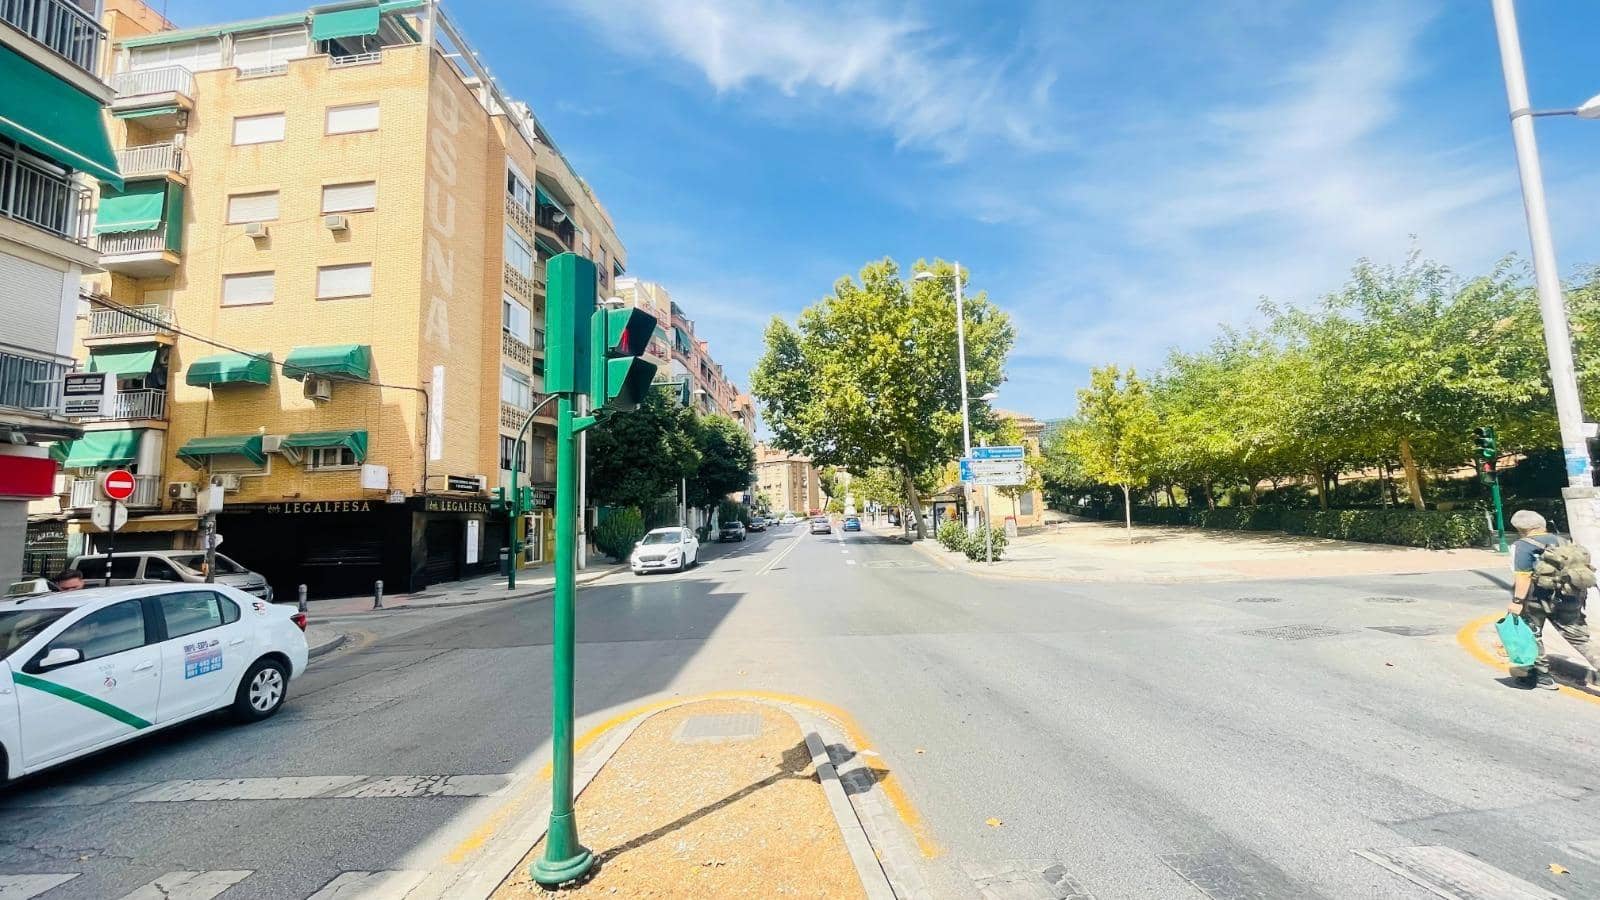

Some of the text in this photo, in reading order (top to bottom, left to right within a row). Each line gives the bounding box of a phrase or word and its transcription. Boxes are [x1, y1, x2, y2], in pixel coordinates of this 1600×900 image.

[423, 75, 459, 348] OSUNA
[284, 501, 370, 513] LEGALFESA
[441, 501, 487, 512] LEGALFESA
